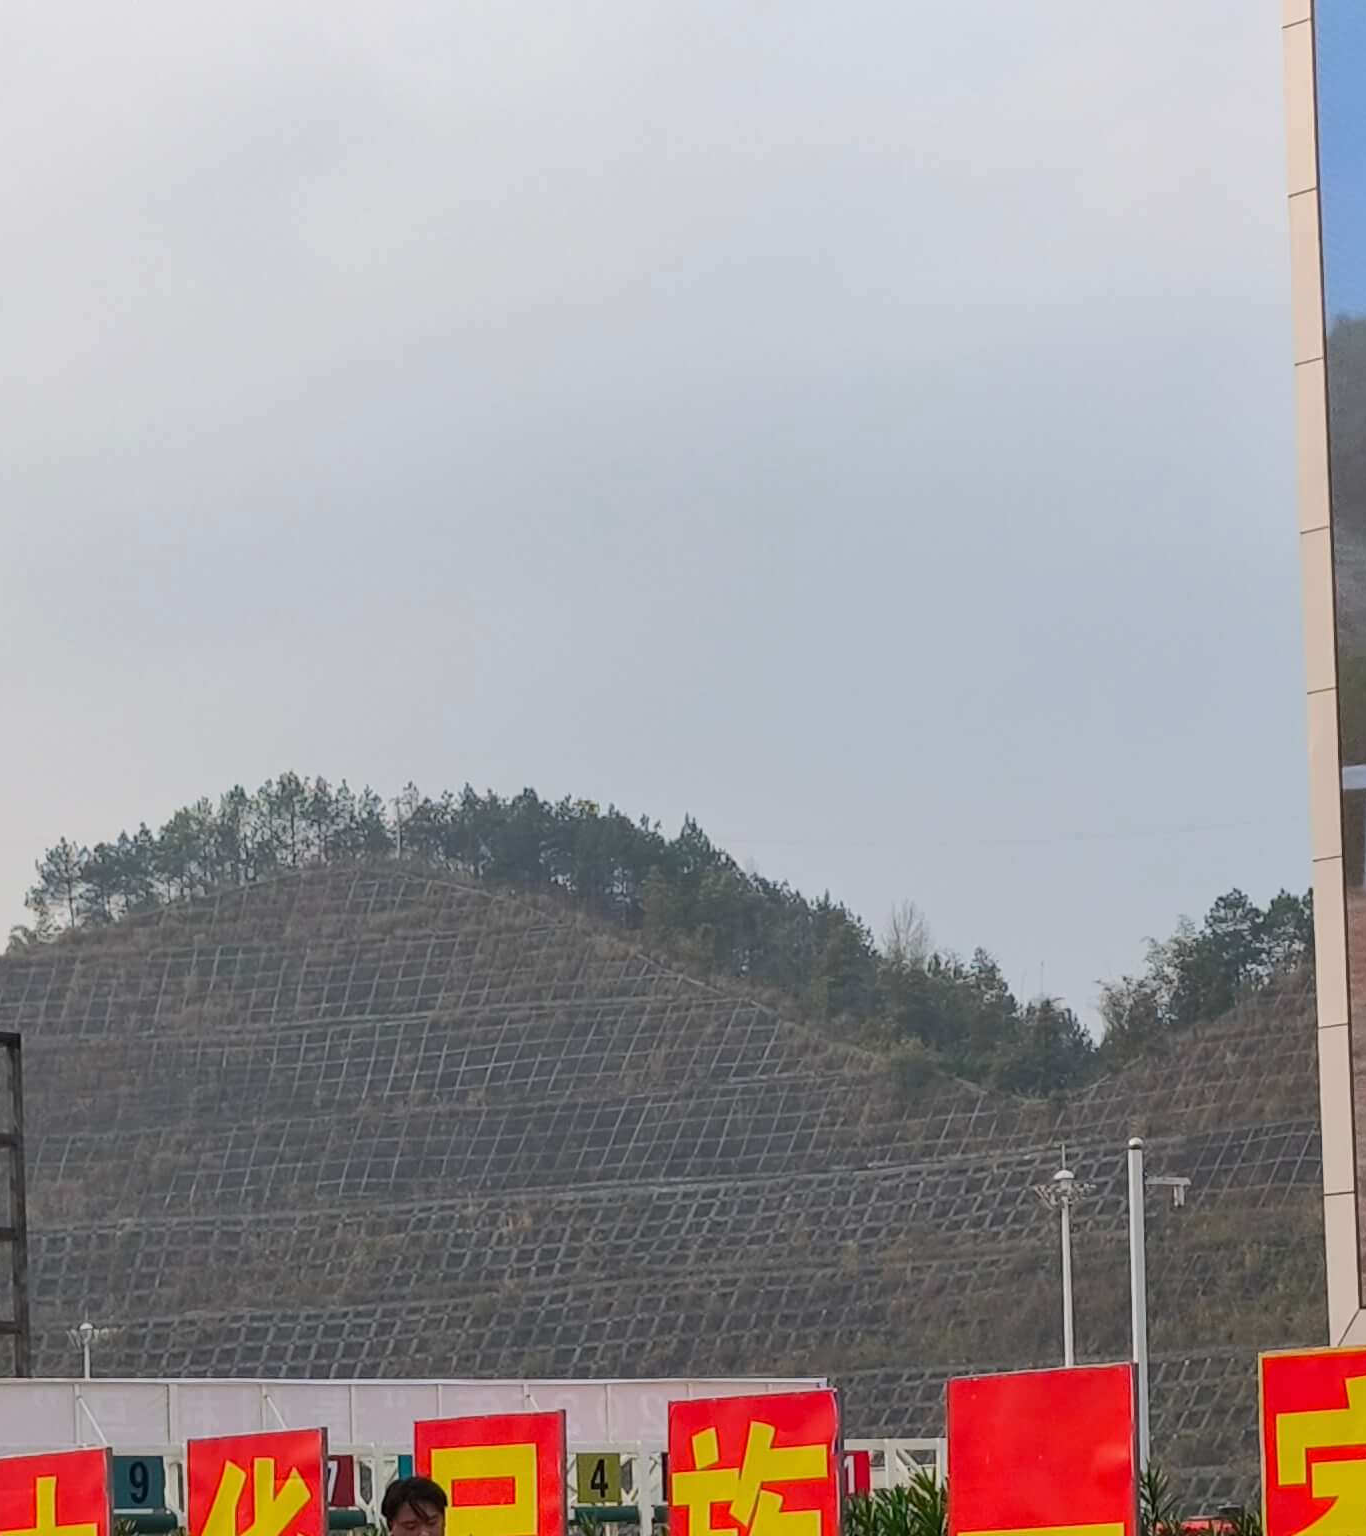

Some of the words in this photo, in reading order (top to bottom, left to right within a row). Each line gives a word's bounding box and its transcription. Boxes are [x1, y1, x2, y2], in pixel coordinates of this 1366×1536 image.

[128, 1460, 150, 1505] 9
[590, 1458, 609, 1499] 4
[842, 1454, 856, 1495] 1
